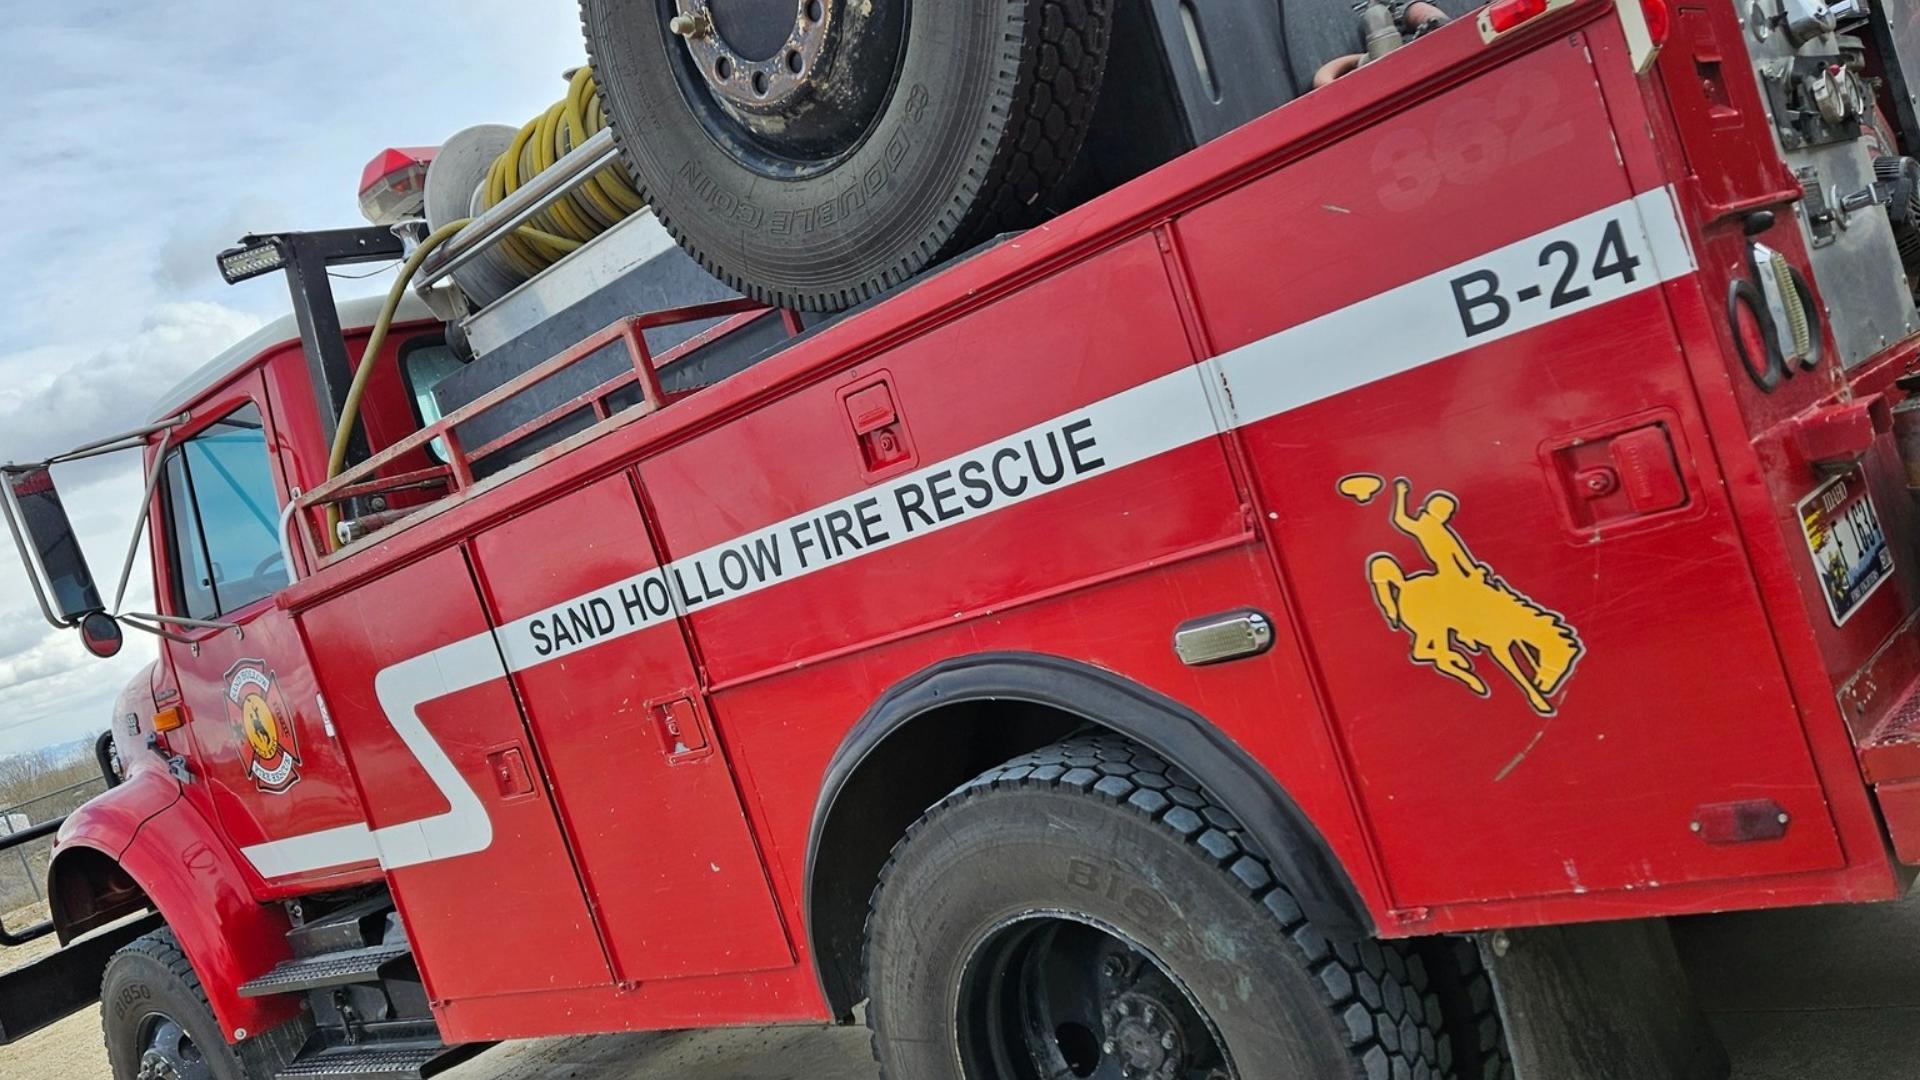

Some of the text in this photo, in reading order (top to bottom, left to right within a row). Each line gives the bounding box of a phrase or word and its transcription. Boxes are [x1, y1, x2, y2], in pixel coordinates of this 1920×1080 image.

[679, 124, 911, 235] DOUBLE COIN
[1450, 219, 1641, 338] B-24
[529, 417, 1106, 656] SAND HOLLOW FIRE RESCUE
[1823, 481, 1848, 513] IDAHO
